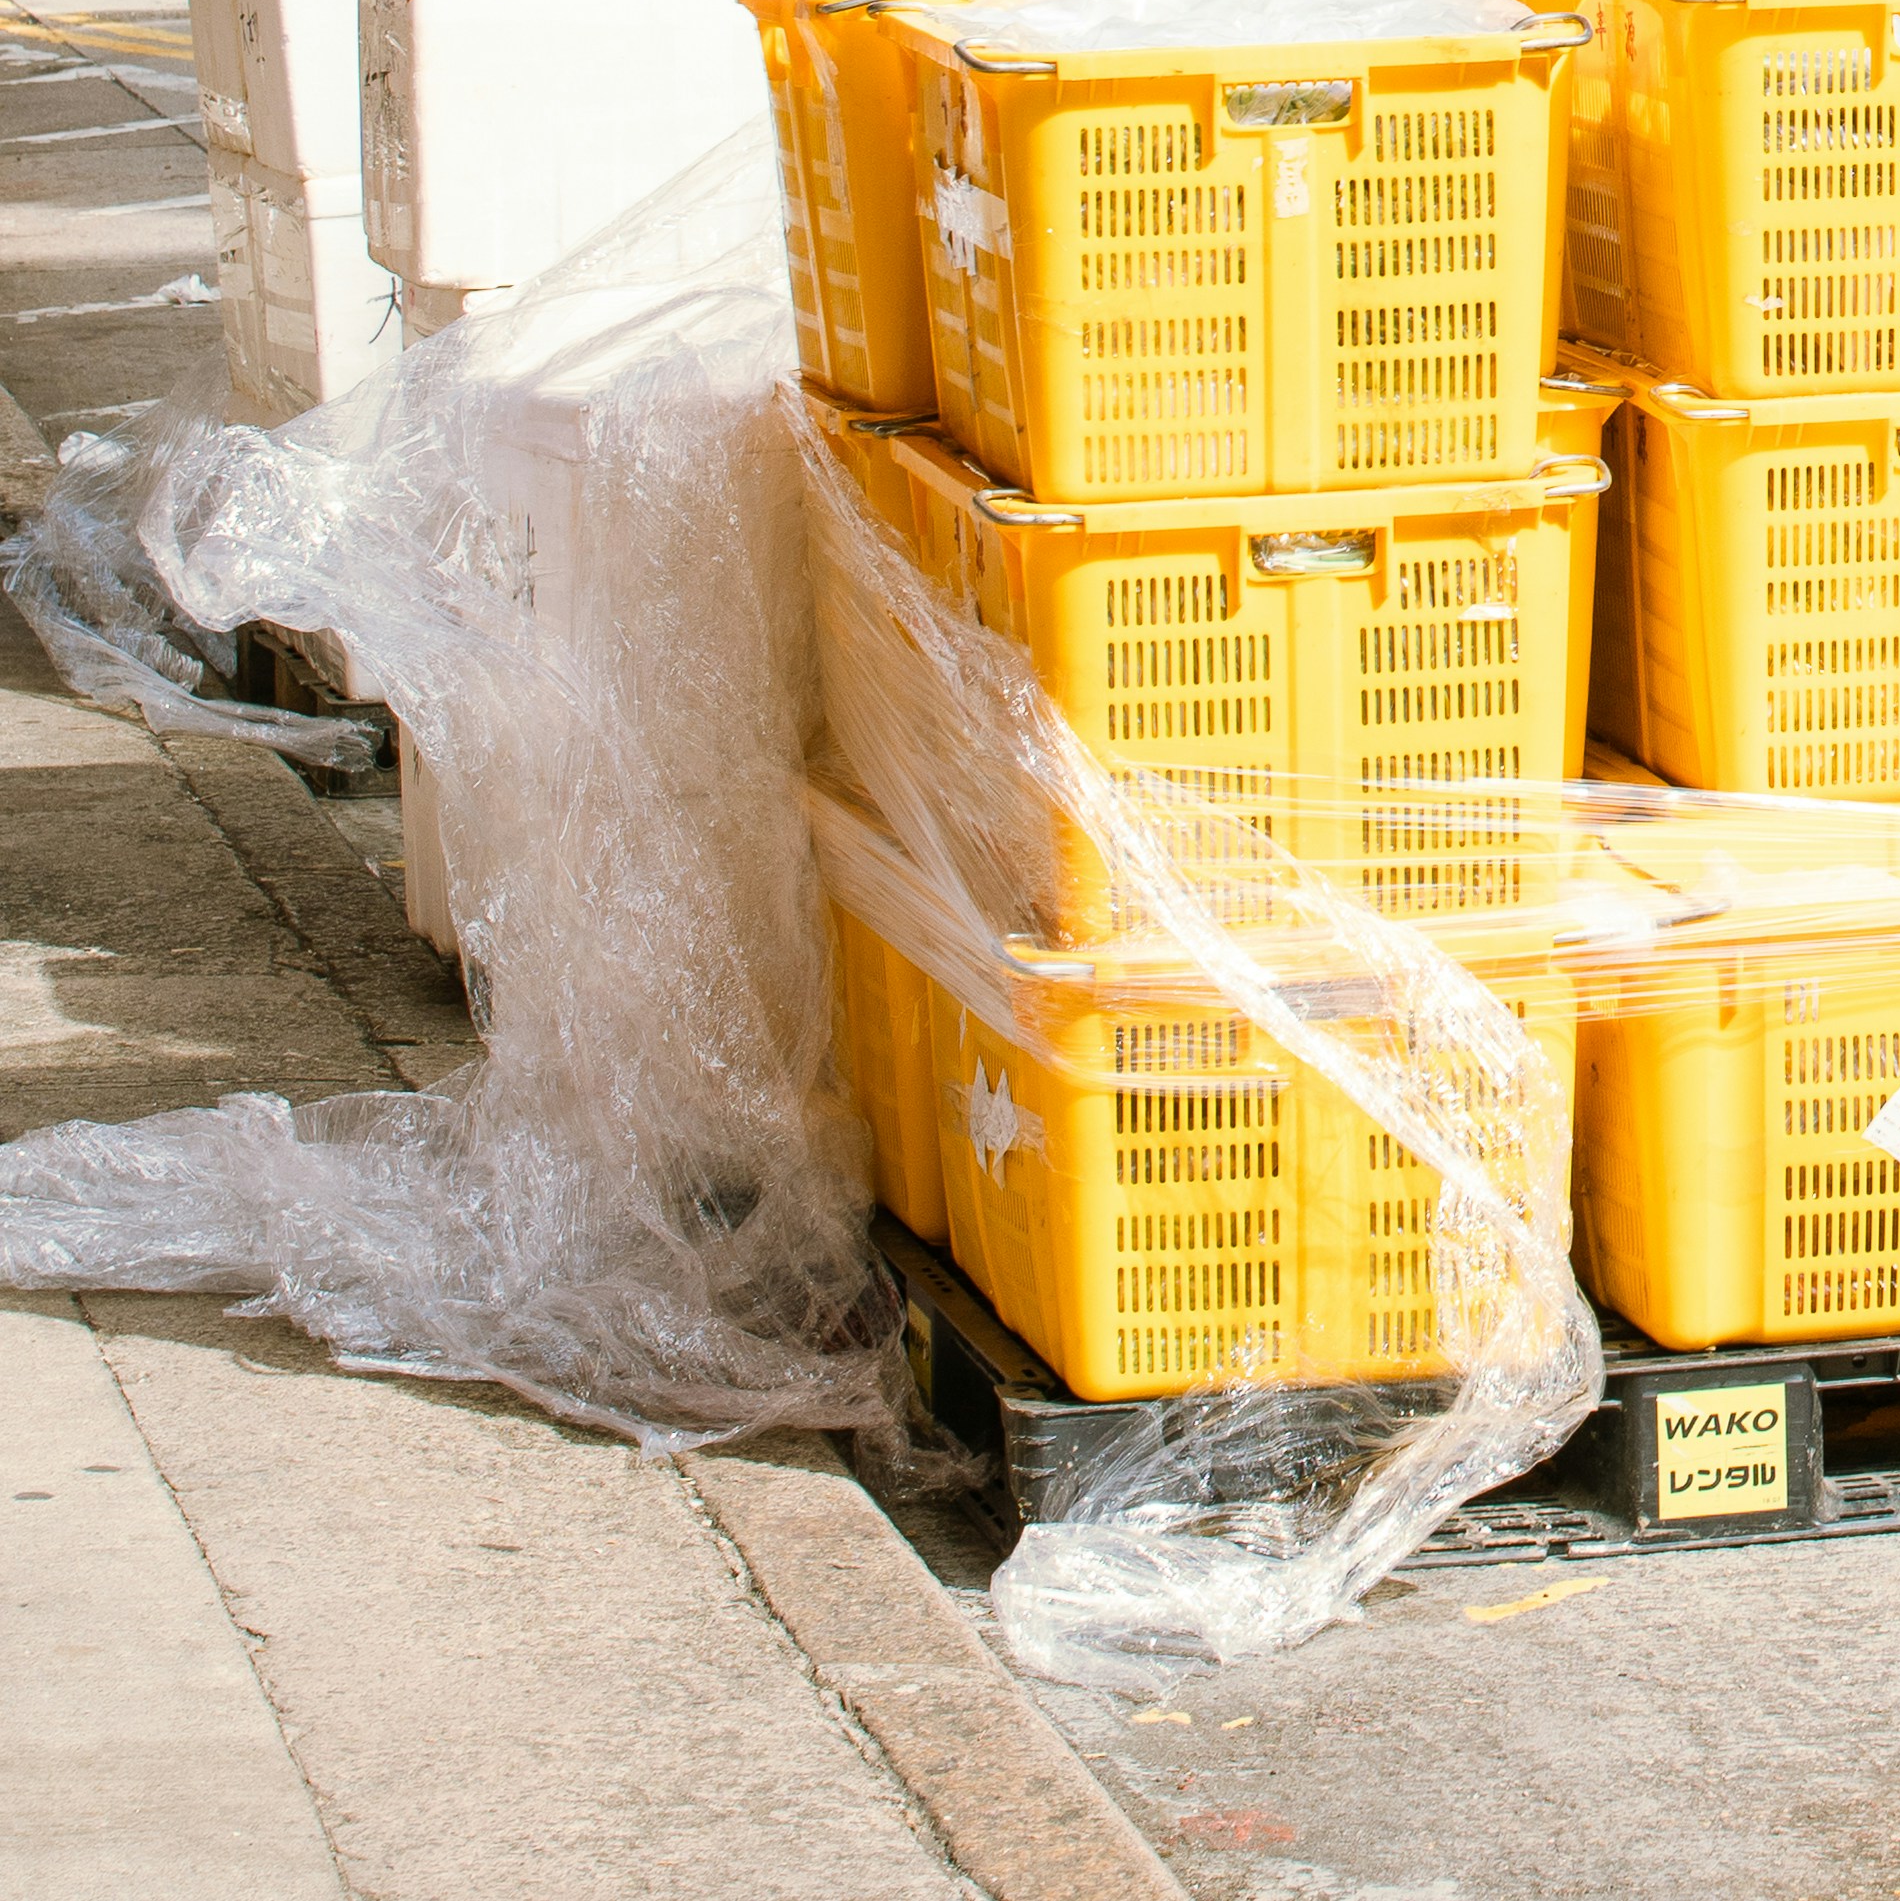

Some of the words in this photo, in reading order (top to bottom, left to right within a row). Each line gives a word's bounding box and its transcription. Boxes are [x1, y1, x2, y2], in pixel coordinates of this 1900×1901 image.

[1665, 1409, 1778, 1440] WAKO
[1670, 1463, 1776, 1494] レンタル
